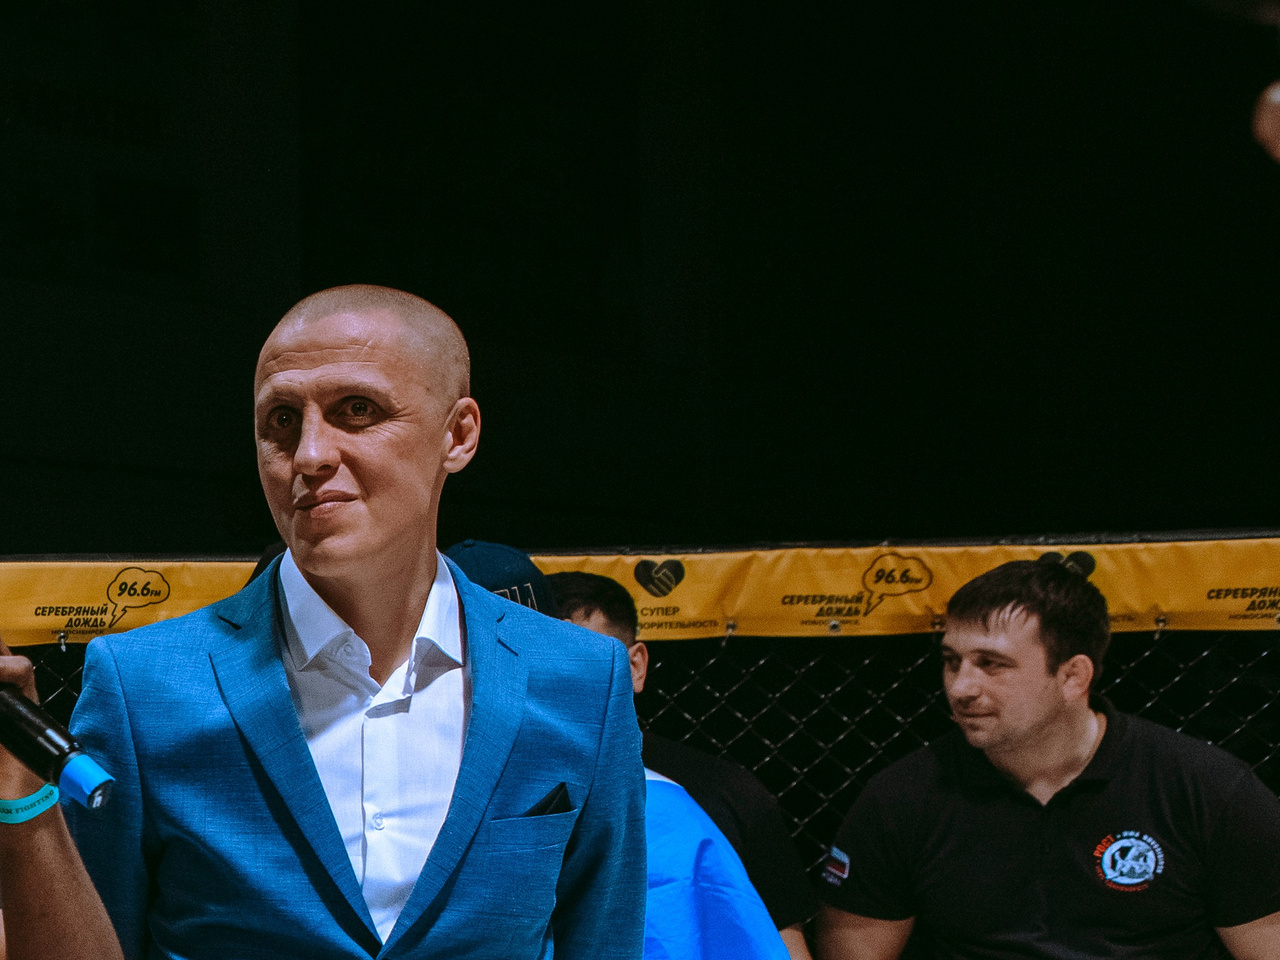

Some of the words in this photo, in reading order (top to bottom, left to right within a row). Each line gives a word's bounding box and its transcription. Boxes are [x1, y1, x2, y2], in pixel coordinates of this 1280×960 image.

[781, 590, 864, 605] СЕРЕБРЯНЫЙ
[1207, 587, 1280, 600] СЕРЕБРЯН
[34, 603, 109, 616] СЕРЕБРЯНЫЙ
[640, 606, 680, 617] СУПЕР
[815, 606, 861, 617] ДОЖДЬ
[64, 617, 107, 628] ДОЖДЬ
